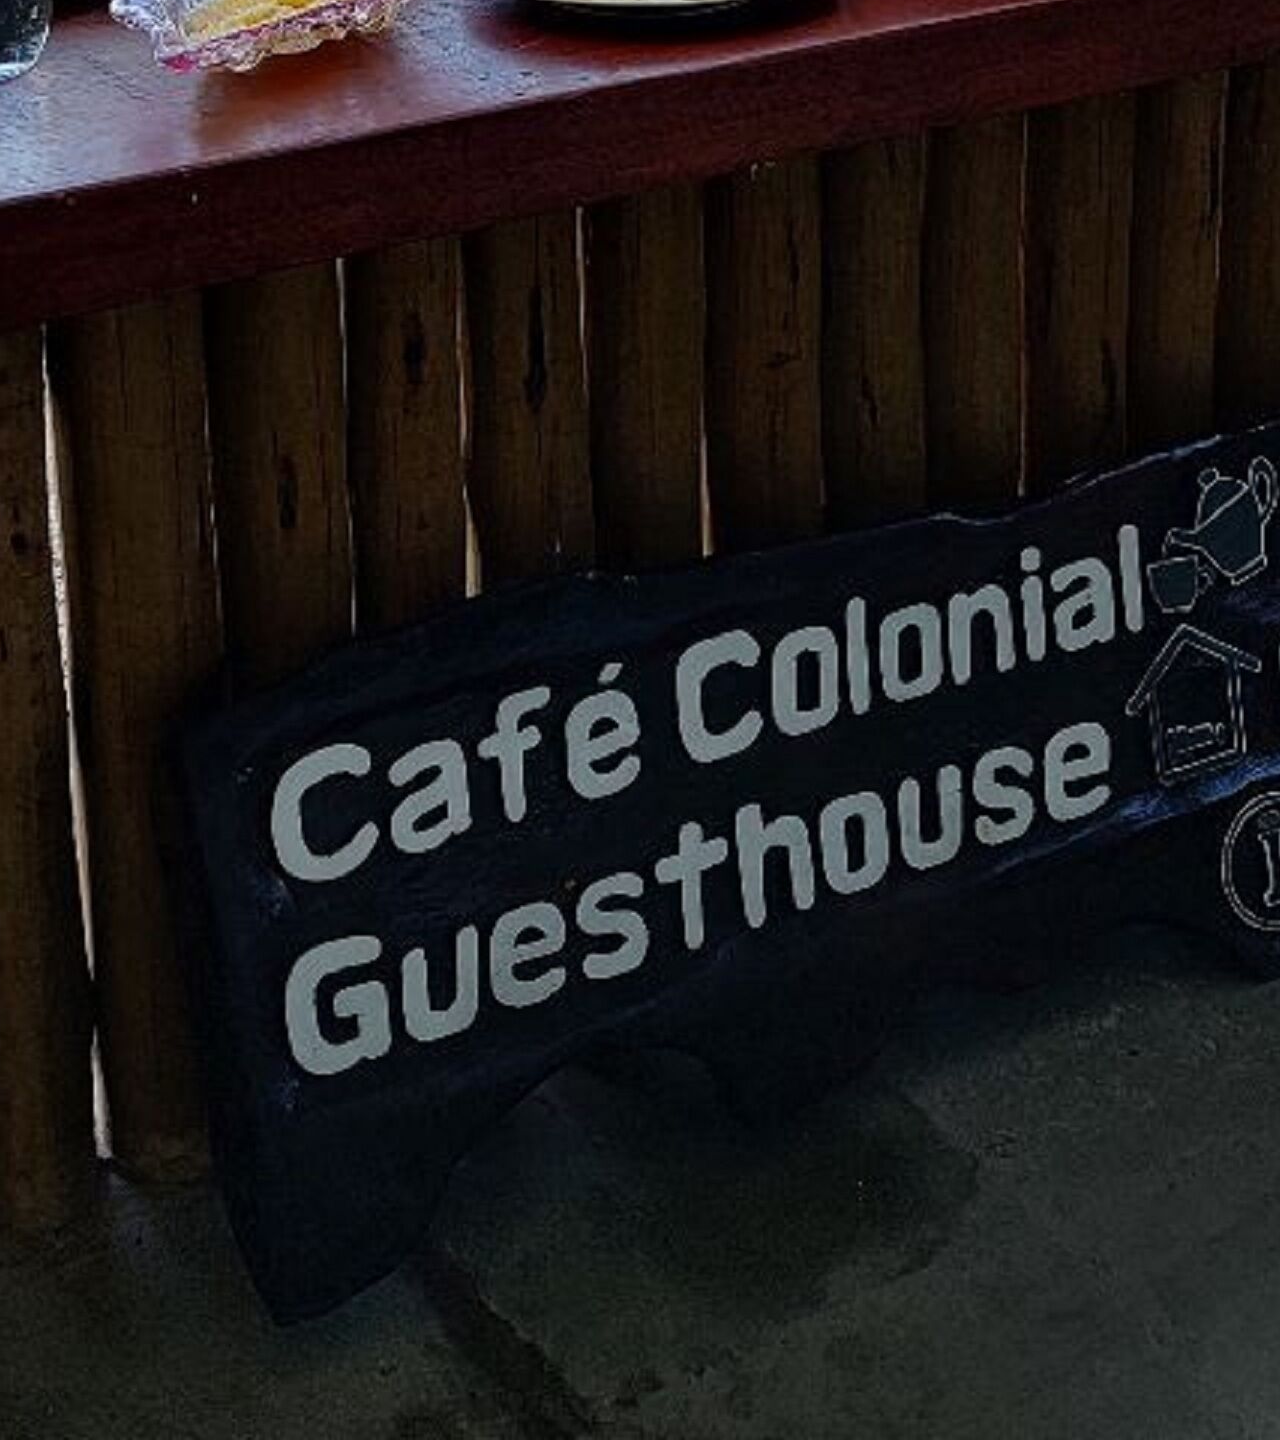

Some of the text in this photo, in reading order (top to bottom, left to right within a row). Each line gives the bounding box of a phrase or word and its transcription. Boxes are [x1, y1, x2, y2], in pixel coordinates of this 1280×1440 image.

[270, 662, 641, 882] Café
[675, 524, 1143, 763] Colonial
[285, 722, 1111, 1075] Guesthouse
